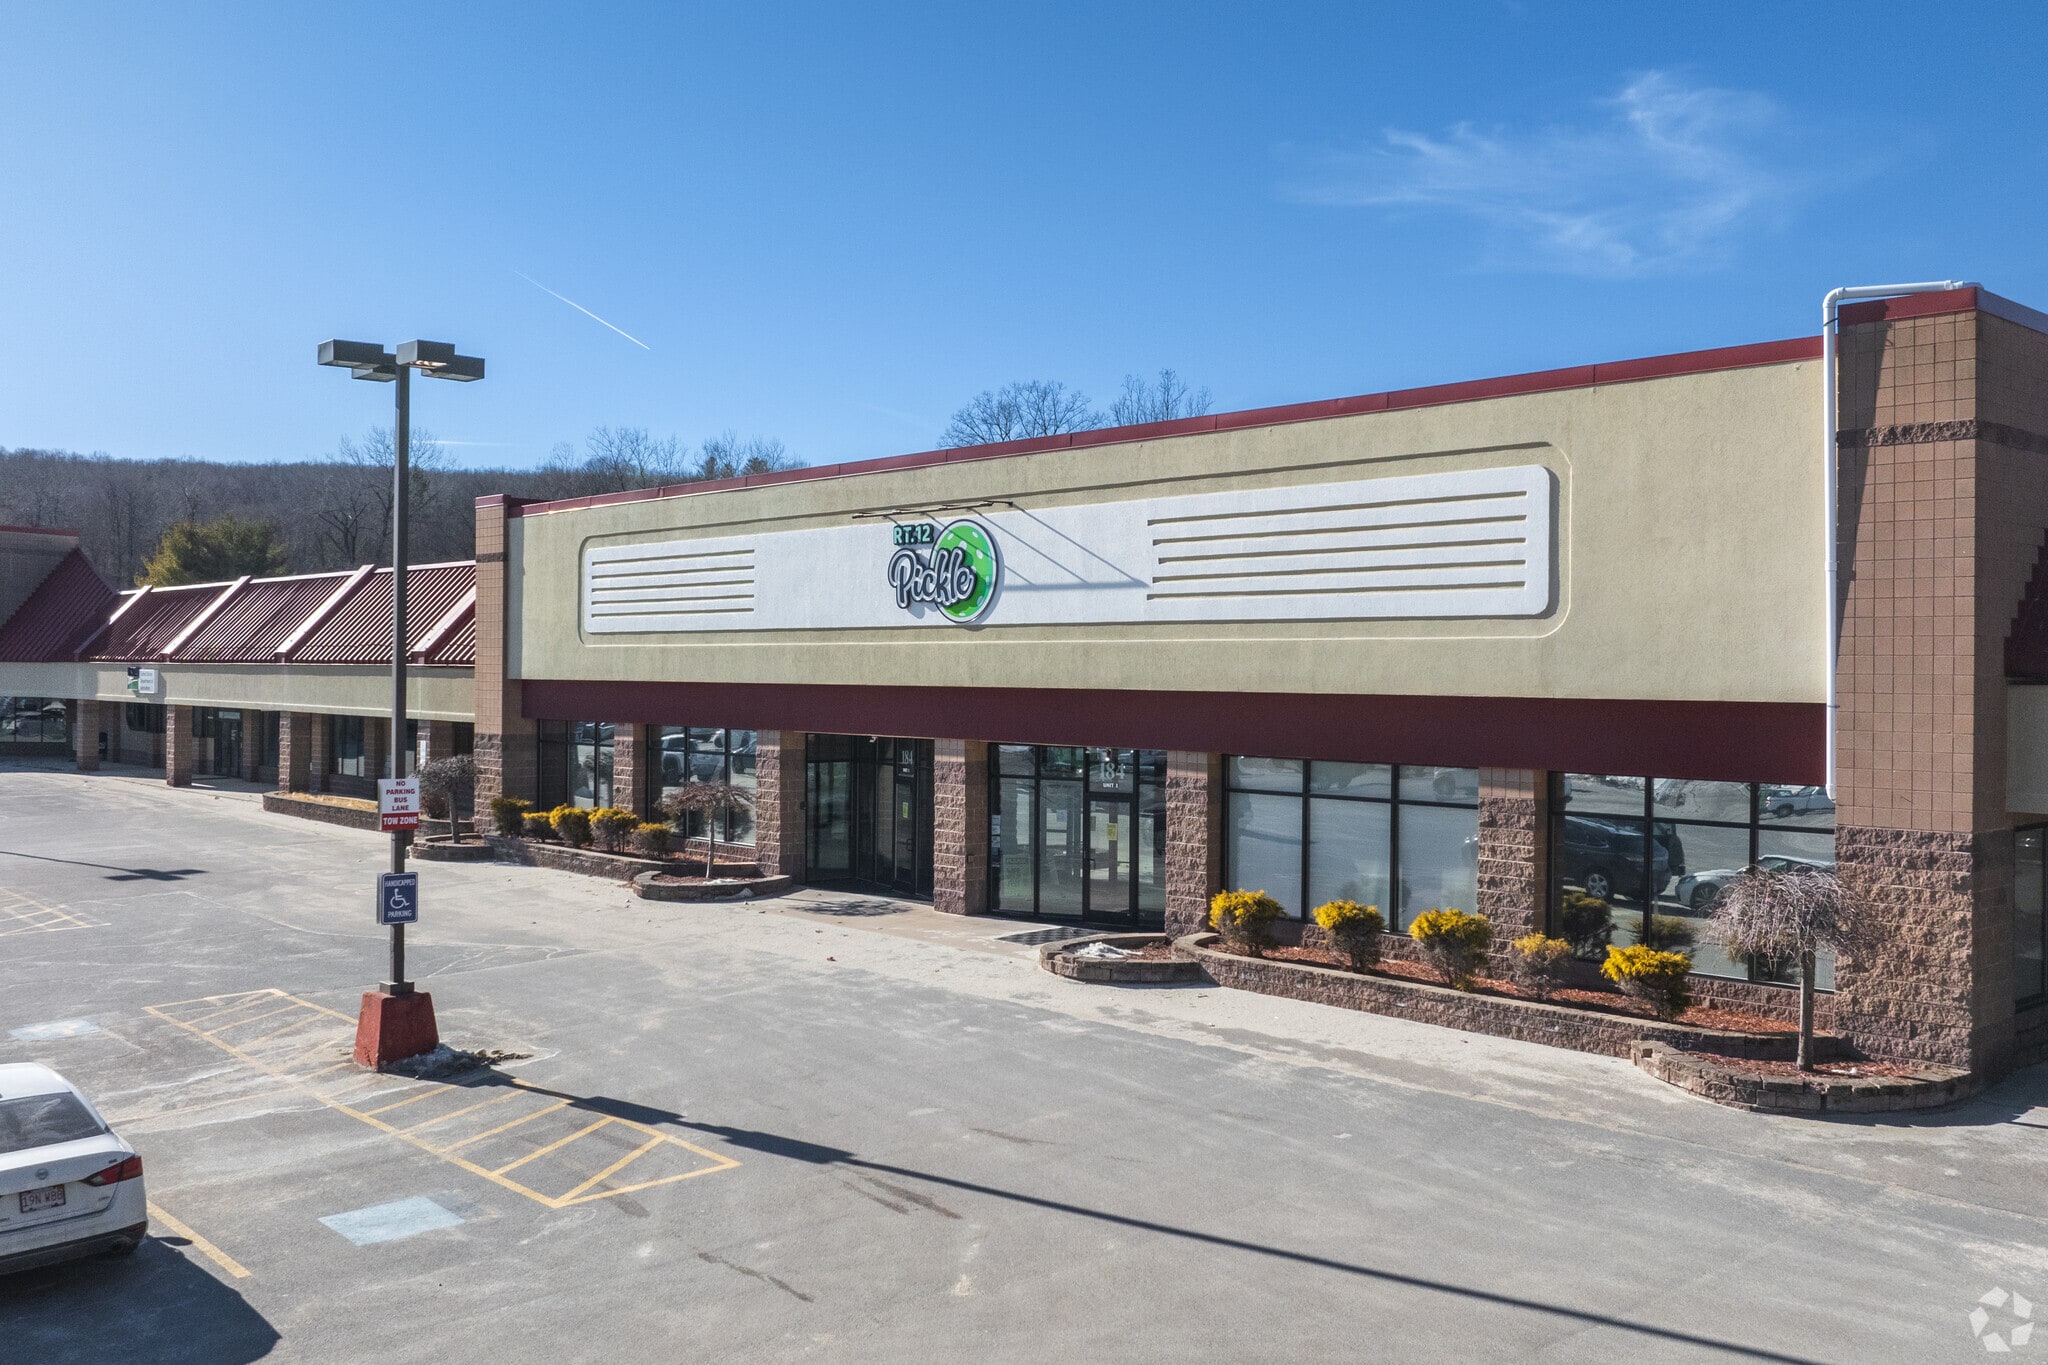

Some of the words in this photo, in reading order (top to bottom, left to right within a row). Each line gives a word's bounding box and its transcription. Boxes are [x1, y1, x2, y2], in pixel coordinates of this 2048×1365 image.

[893, 524, 933, 546] RT.12
[888, 547, 977, 609] Pickle
[1100, 762, 1125, 781] 184
[386, 788, 415, 796] PARKING
[394, 796, 408, 804] BUS
[392, 804, 410, 812] LANE
[383, 817, 399, 826] TOW
[399, 815, 418, 825] ZONE
[384, 878, 415, 887] HANDICAPPED
[387, 909, 412, 918] PARKING
